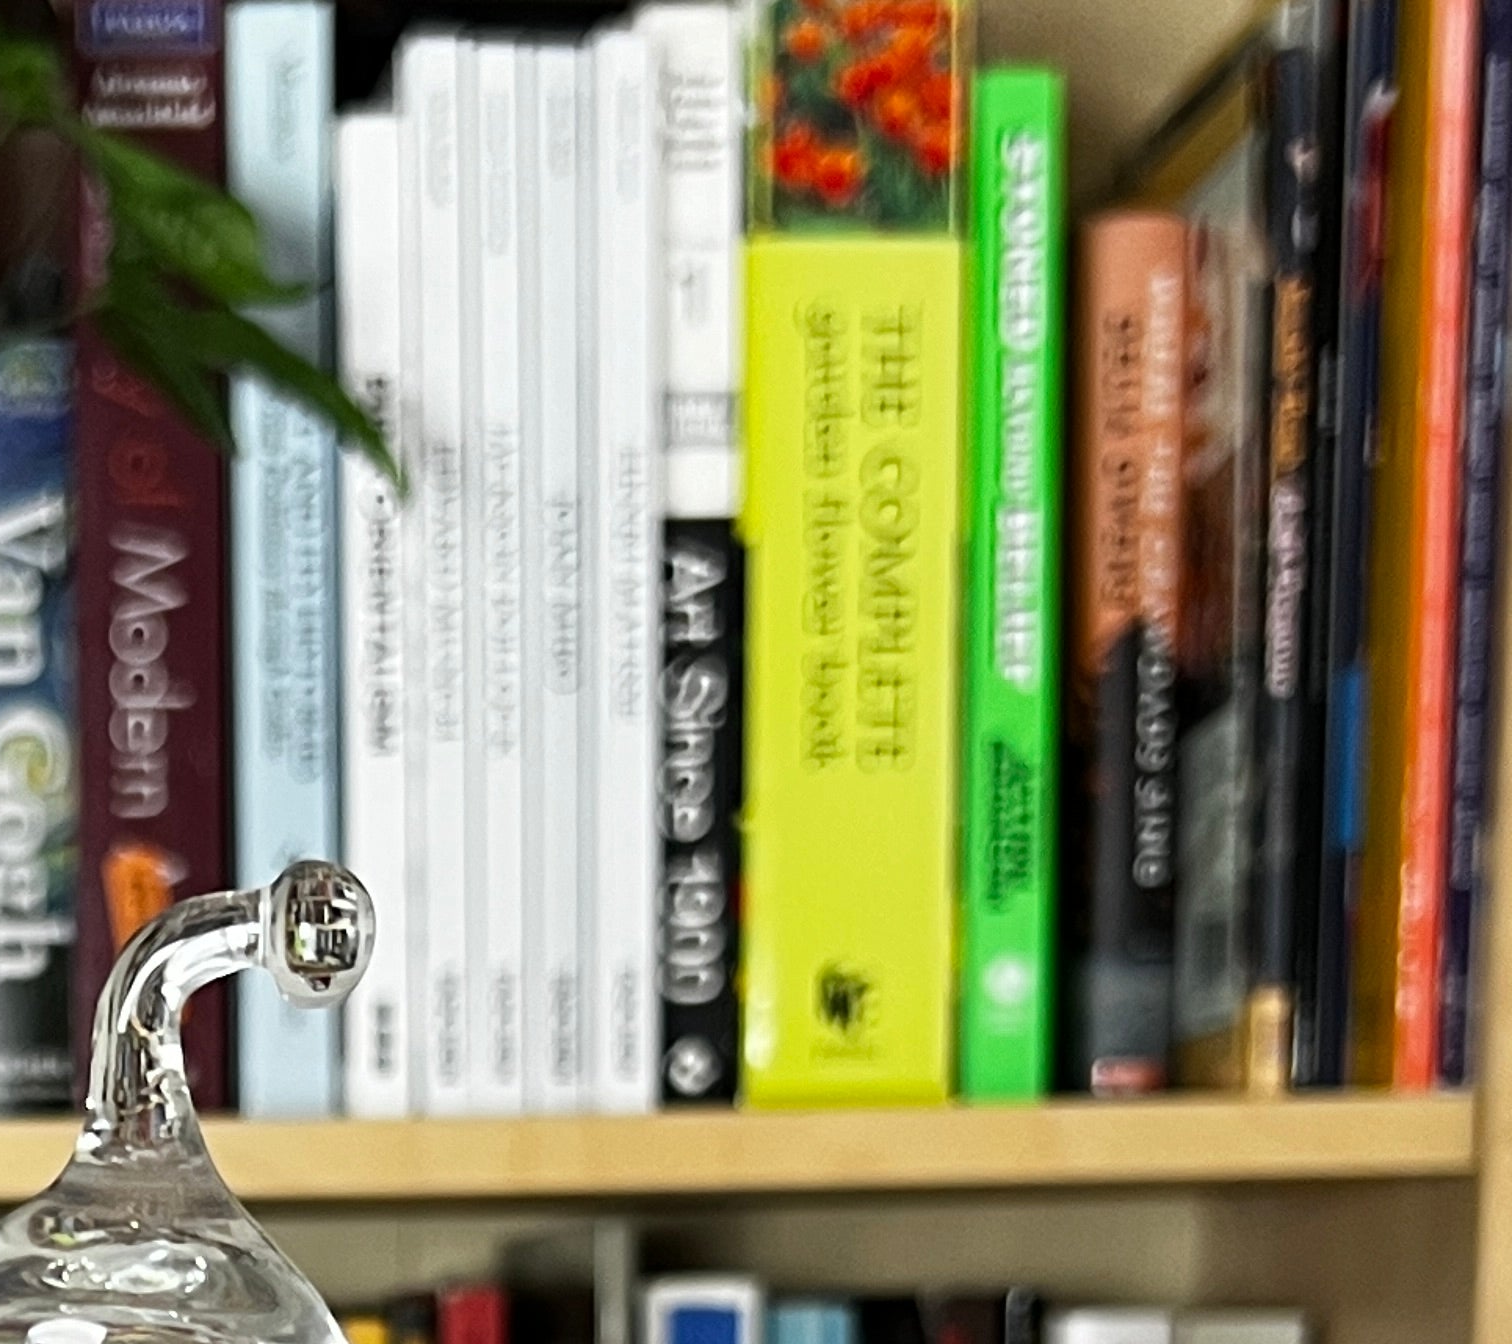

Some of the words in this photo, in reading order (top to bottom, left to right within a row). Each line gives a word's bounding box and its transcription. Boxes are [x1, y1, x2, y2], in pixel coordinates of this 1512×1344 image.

[862, 304, 922, 427] THE
[108, 526, 196, 819] Modern
[662, 540, 728, 645] Art
[857, 447, 921, 773] COMPLETE
[660, 653, 729, 844] Since
[660, 850, 727, 1006] 1900
